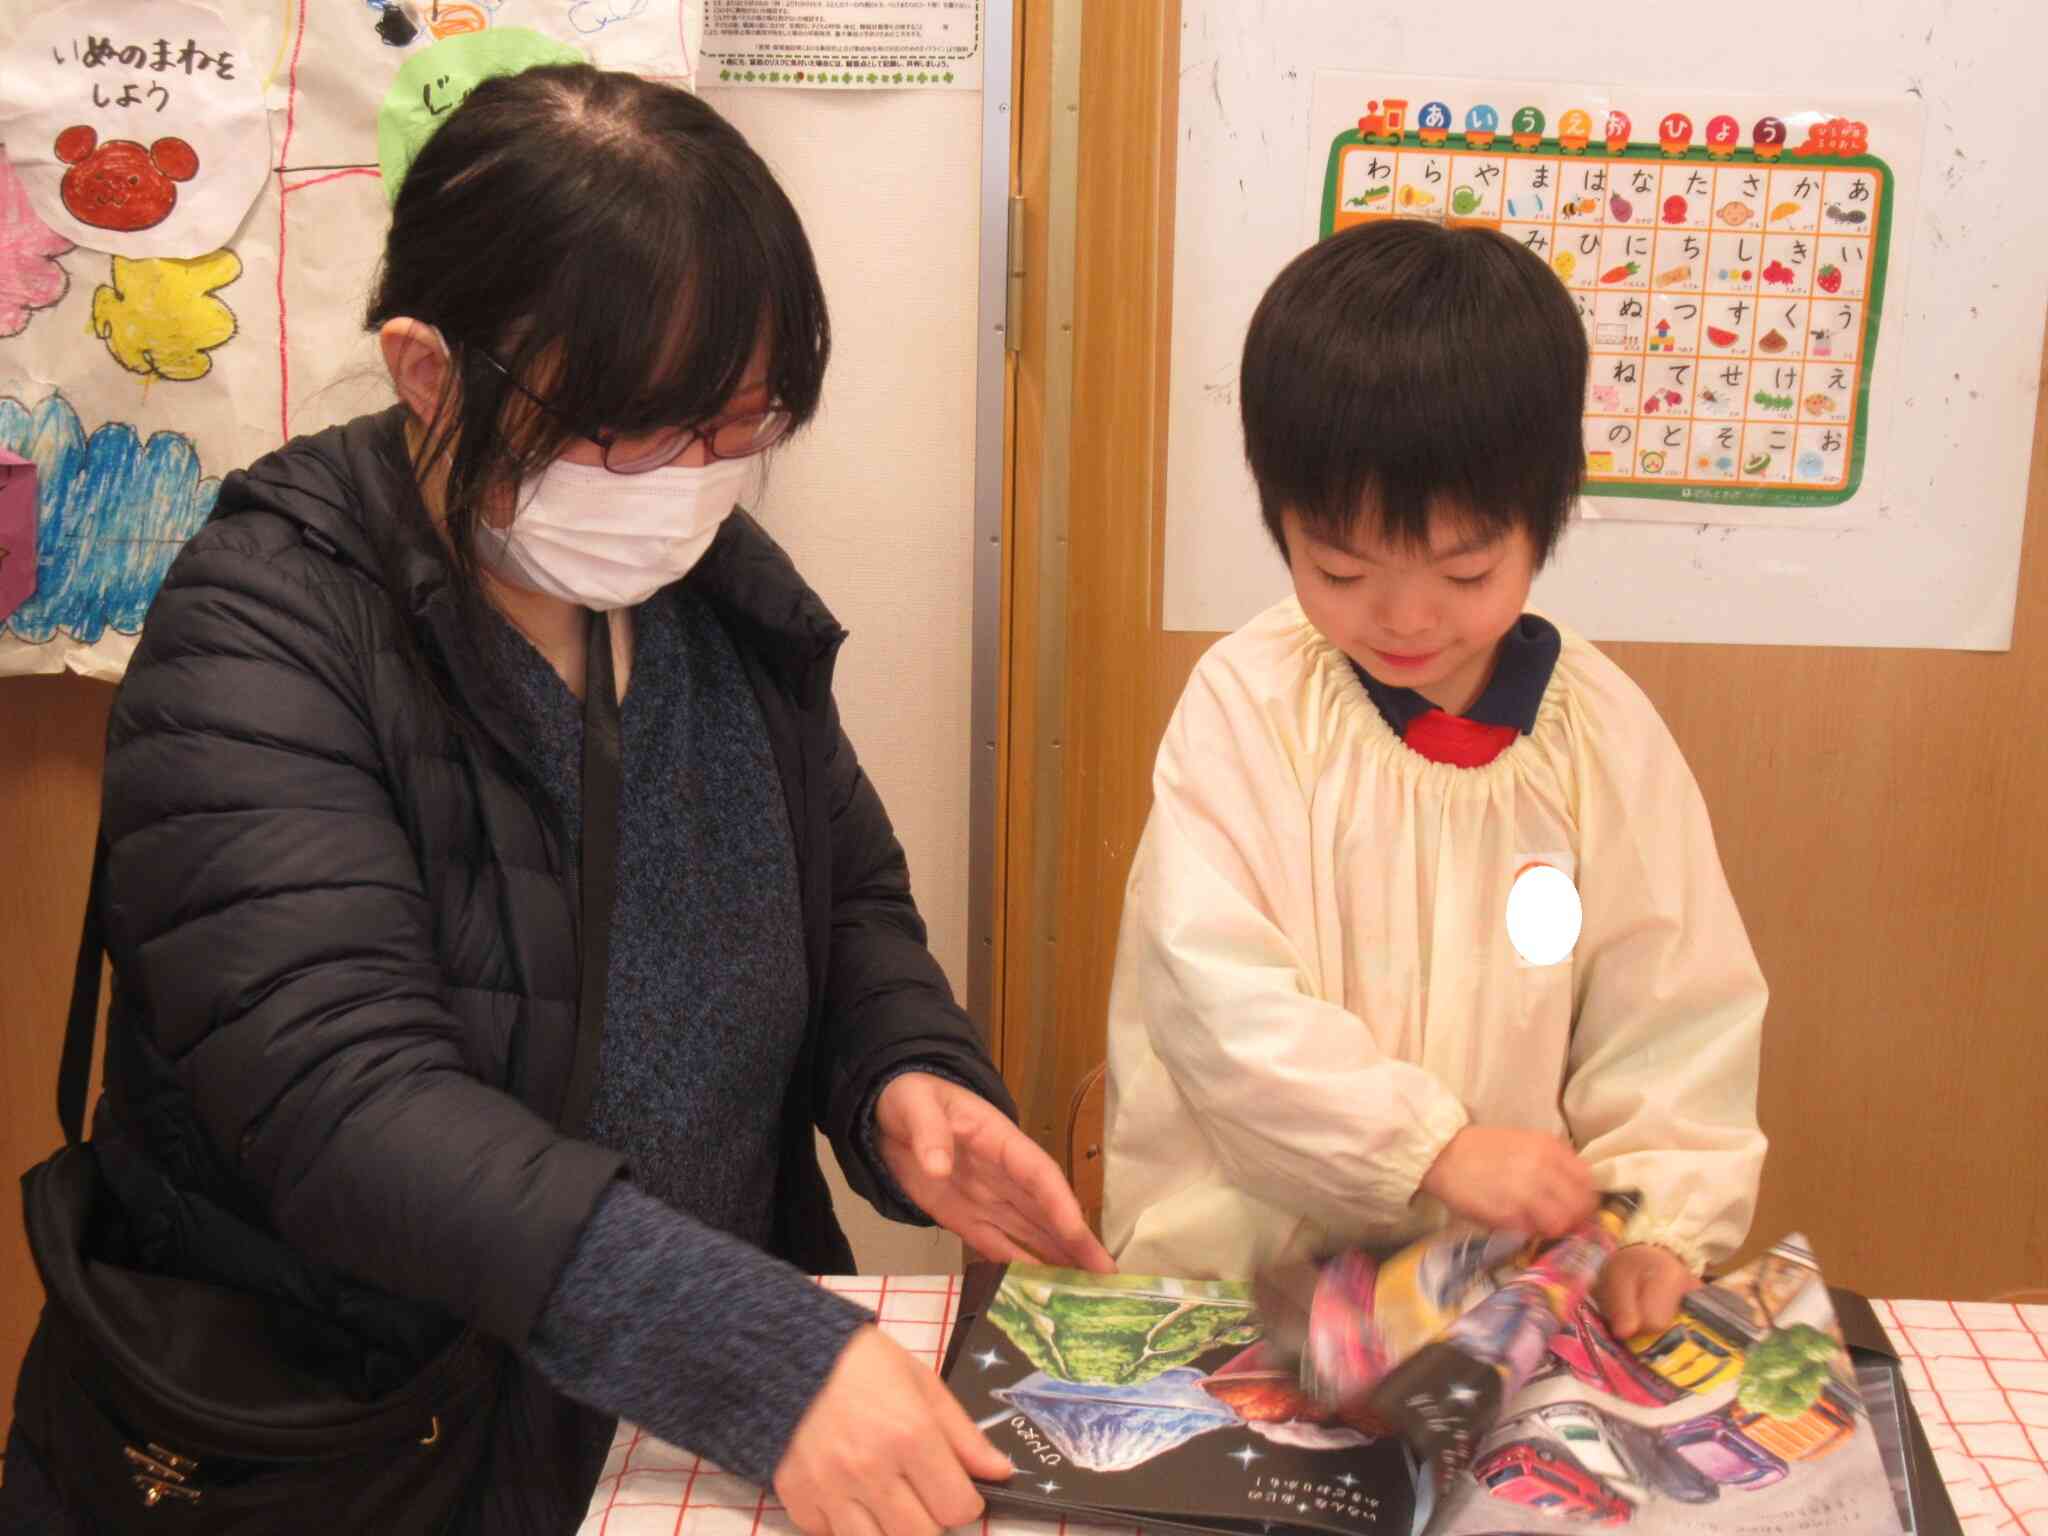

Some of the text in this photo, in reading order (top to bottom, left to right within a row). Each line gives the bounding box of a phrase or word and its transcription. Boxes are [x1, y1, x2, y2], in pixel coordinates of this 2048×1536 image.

[52, 35, 235, 80] いぬのまねを
[93, 80, 170, 112] しよう
[423, 75, 470, 115] じ
[1368, 157, 1870, 202] わ ら や ま は な た さ か あ
[1579, 233, 1600, 255] ひ
[1625, 235, 1647, 256] に
[1683, 235, 1700, 259] ち
[1738, 238, 1752, 262] し
[1791, 240, 1808, 264] き
[1841, 246, 1863, 263] い
[1619, 297, 1643, 317] ぬ
[1673, 304, 1697, 320] つ
[1728, 301, 1749, 325] す
[1785, 303, 1797, 328] く
[1838, 304, 1852, 329] う
[1613, 360, 1847, 390] ね て せ け え
[1608, 424, 1842, 452] の と そ こ お
